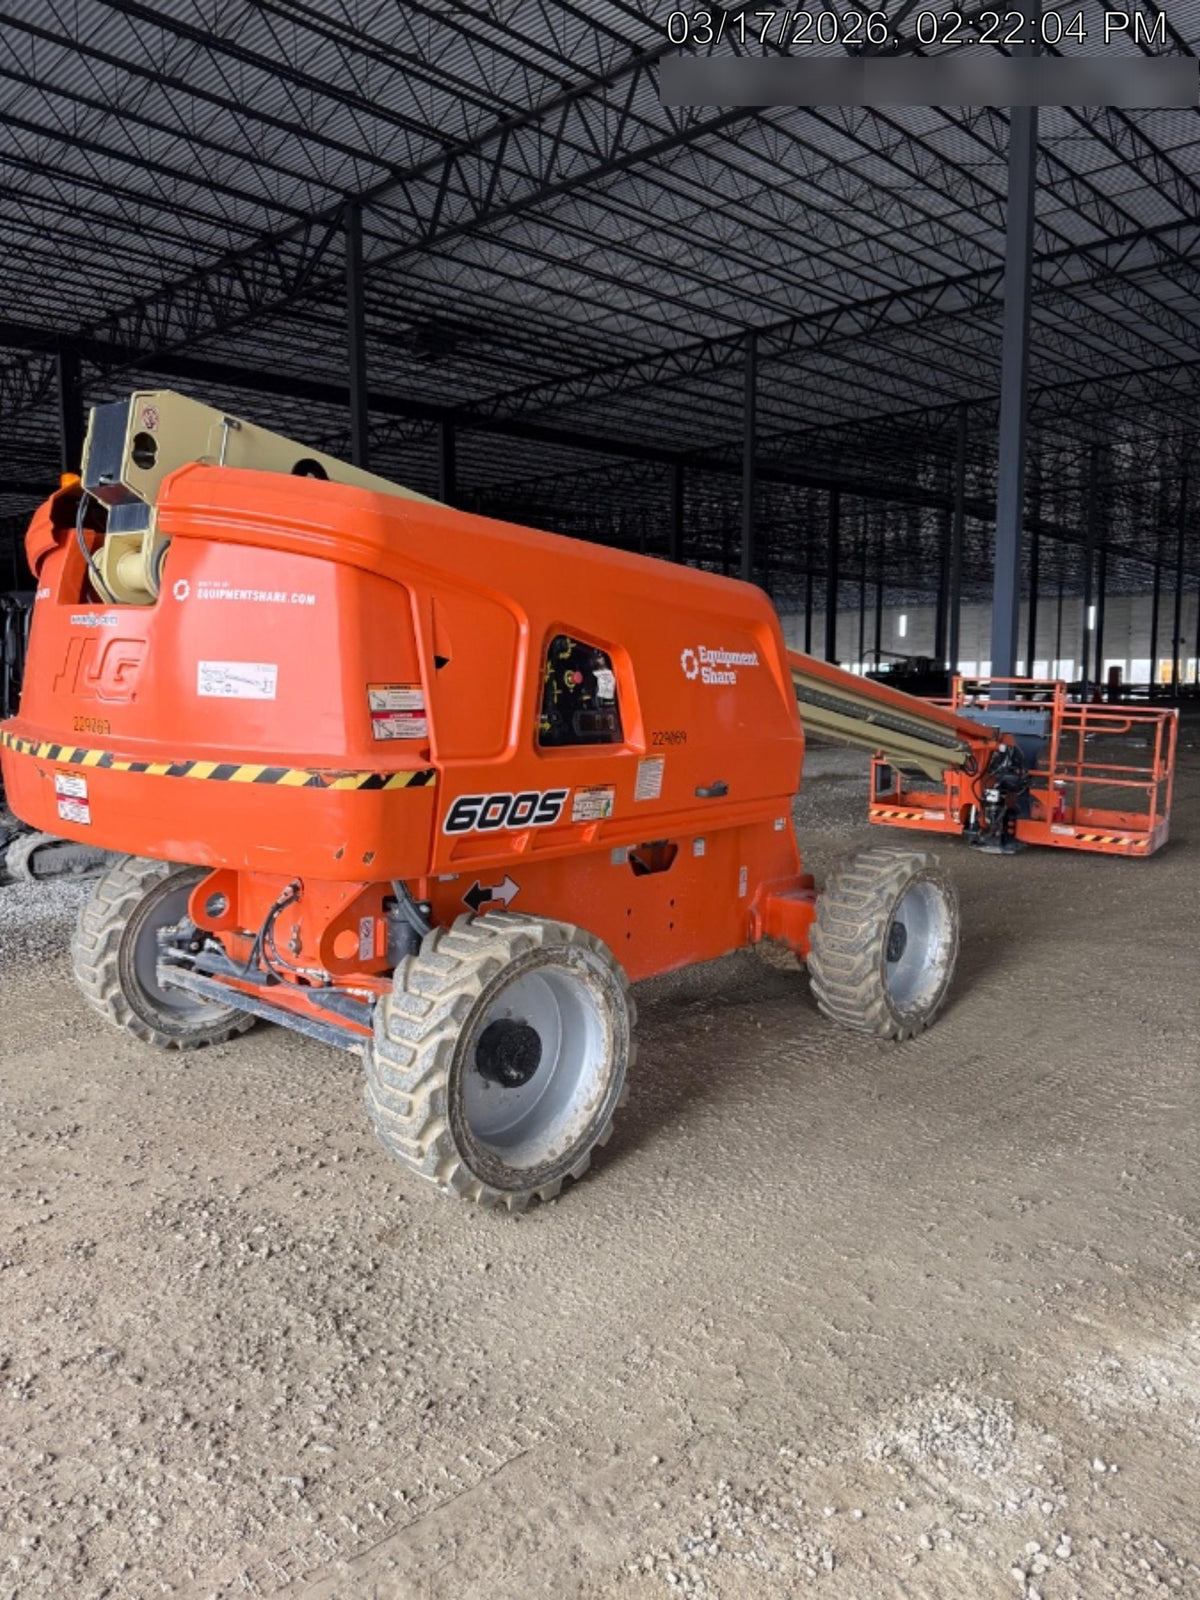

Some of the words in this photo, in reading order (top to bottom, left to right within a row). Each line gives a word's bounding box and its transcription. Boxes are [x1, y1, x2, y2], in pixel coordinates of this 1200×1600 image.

[196, 588, 316, 606] EQUIPMENTSHARE.COM
[697, 645, 760, 669] Equipment
[701, 666, 738, 685] Share
